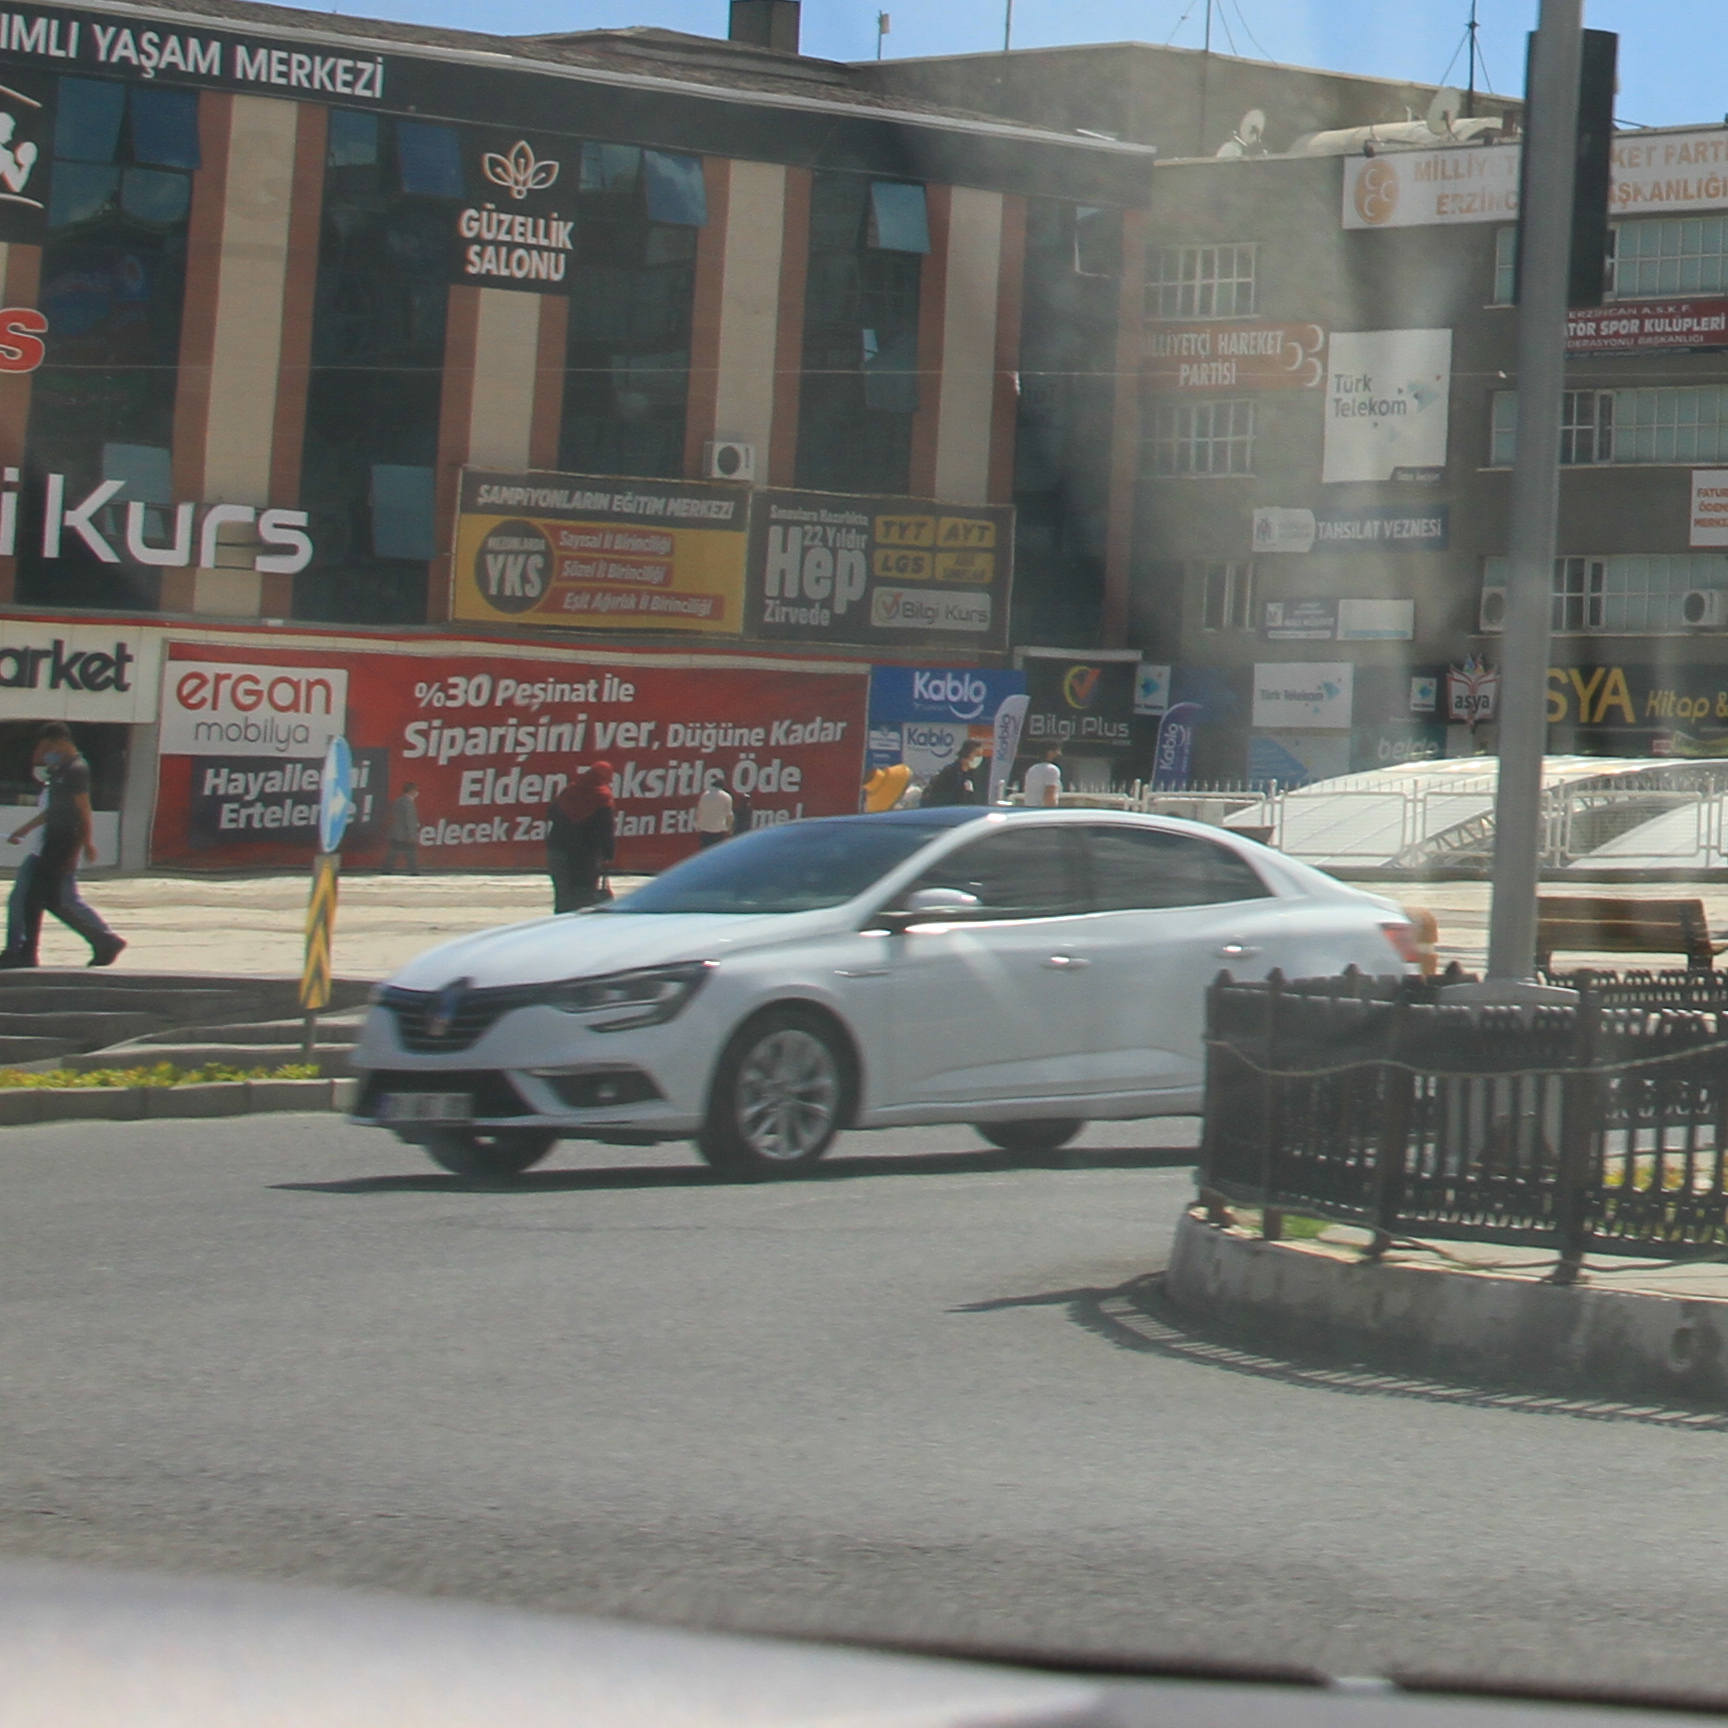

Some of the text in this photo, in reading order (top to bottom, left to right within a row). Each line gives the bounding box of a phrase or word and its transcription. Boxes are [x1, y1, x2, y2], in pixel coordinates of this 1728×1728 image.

[93, 23, 221, 78] YAŞAM
[234, 44, 384, 99] MERKEZİ
[458, 202, 574, 250] GÜZELLİK
[464, 244, 566, 281] SALONU
[1601, 312, 1726, 335] SPOR KULÜPLERİ
[1218, 330, 1284, 355] HAREKET
[1179, 359, 1237, 386] PARTİSİ
[1334, 374, 1372, 393] Türk
[1333, 396, 1407, 418] Telekom
[612, 492, 667, 515] EĞİTİM
[43, 473, 313, 574] Kurs
[804, 525, 868, 549] 22 Yıldır
[882, 520, 989, 544] TYT AYT
[1318, 520, 1379, 540] TAHSİLAT
[1383, 518, 1442, 538] VEZNESİ
[485, 553, 544, 598] YKS
[764, 525, 868, 614] Hep
[881, 553, 925, 574] LGS
[764, 599, 831, 627] Zirvede
[902, 601, 988, 625] Bilgi Kurs
[415, 673, 635, 712] %30 Peşinat İle
[913, 671, 987, 703] Kablo
[1454, 693, 1490, 713] asya
[1646, 690, 1710, 723] Kitap
[195, 717, 310, 752] mobilya
[402, 713, 586, 765] Siparişini
[594, 720, 662, 751] ver,
[667, 722, 765, 753] Düğüne
[770, 717, 847, 746] Kadar
[907, 727, 954, 747] Kablo
[1029, 713, 1130, 740] Bilgi Plus
[1159, 723, 1179, 771] Kablo
[459, 753, 802, 807] Elden aksitle Öde
[419, 815, 507, 847] elecek
